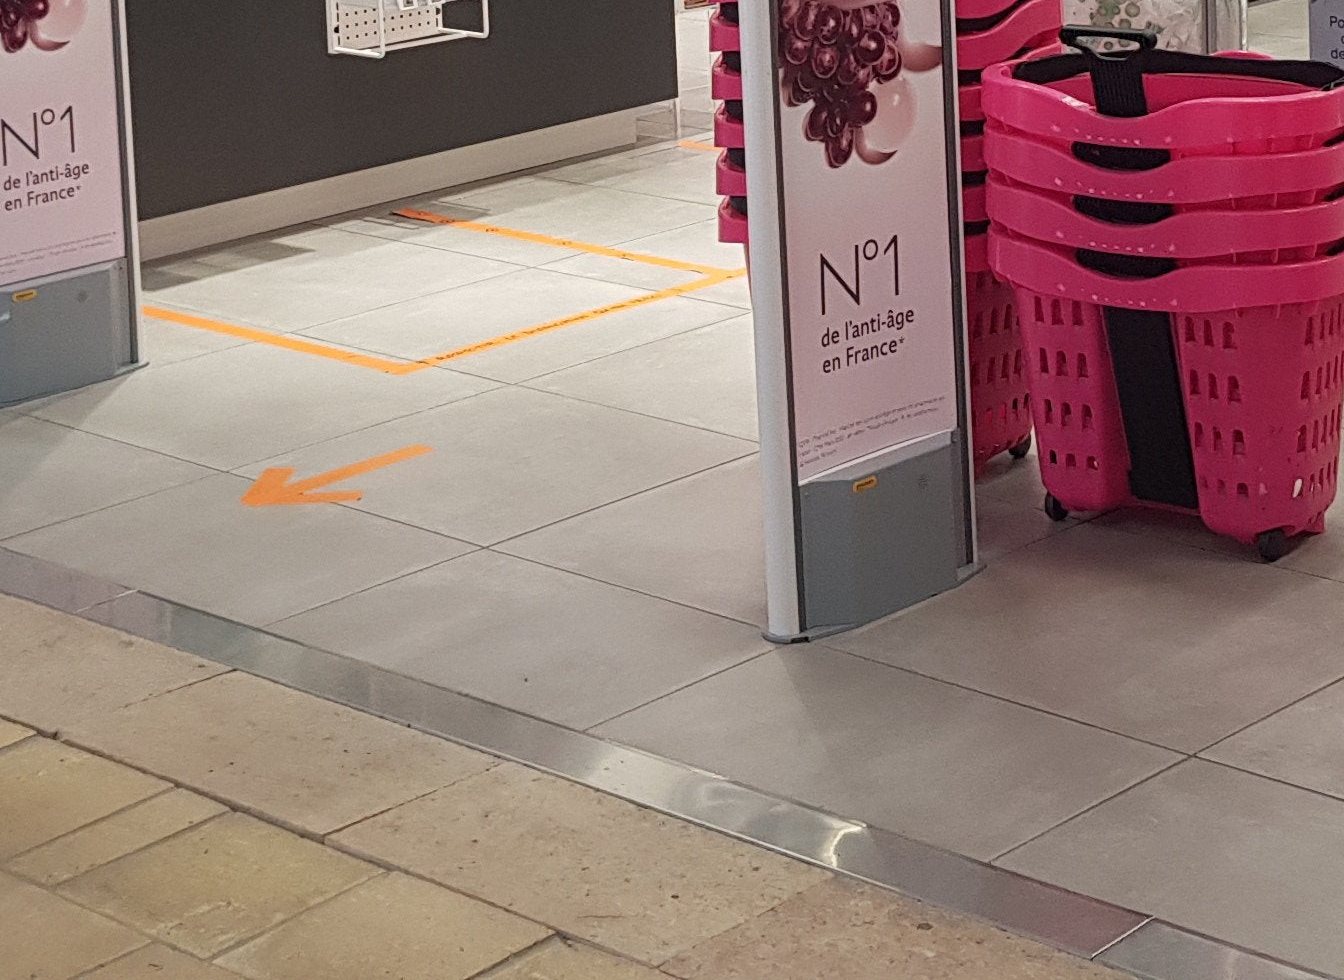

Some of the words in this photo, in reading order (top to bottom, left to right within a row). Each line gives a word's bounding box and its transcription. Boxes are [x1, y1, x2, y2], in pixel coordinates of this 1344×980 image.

[0, 105, 76, 167] N°1
[3, 175, 21, 191] de
[26, 162, 90, 187] l'anti-âge
[4, 197, 22, 211] en
[820, 234, 899, 316] N°1
[821, 326, 840, 348] de
[845, 308, 914, 341] l'anti-âge
[823, 355, 841, 373] en
